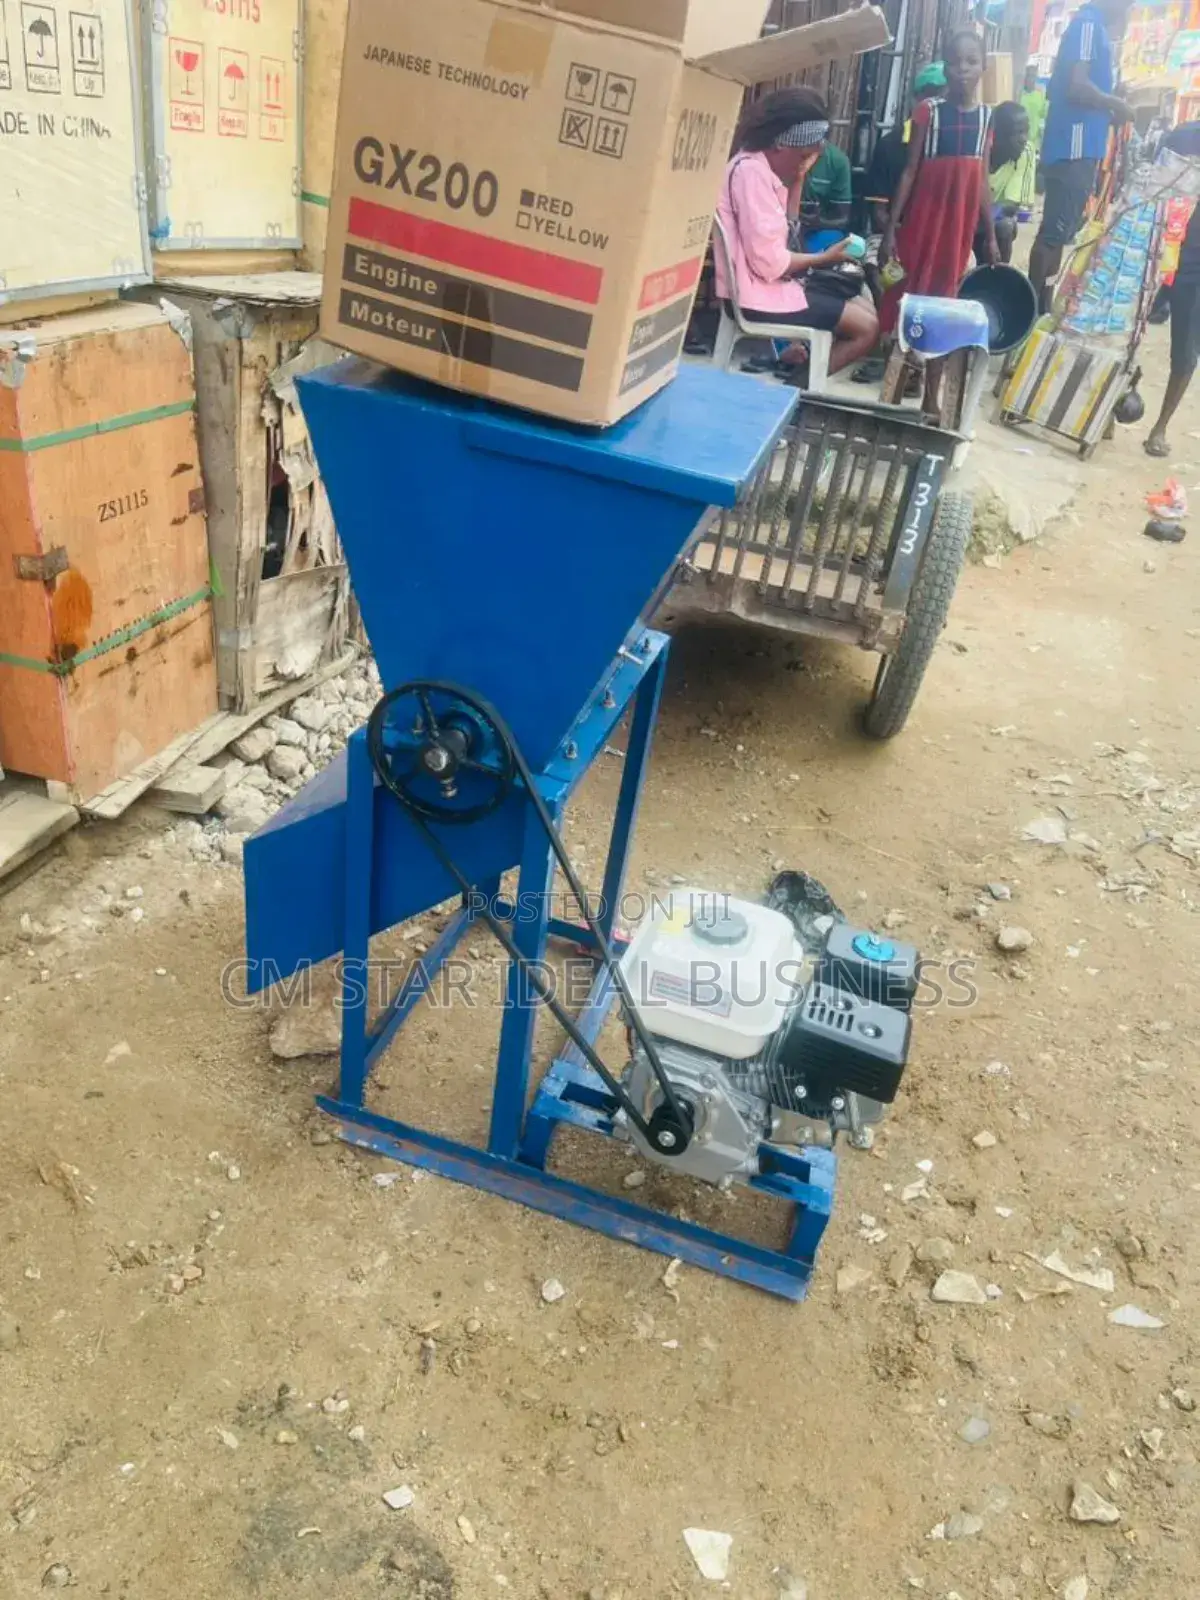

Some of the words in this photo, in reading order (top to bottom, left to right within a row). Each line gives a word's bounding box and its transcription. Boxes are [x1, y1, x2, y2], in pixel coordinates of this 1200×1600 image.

[362, 44, 432, 75] JAPANESE
[437, 62, 531, 101] TECHNOLOGY
[38, 113, 55, 136] IN
[353, 136, 499, 218] GX200
[535, 193, 574, 217] RED
[533, 215, 609, 250] YELLOW
[355, 253, 438, 295] Engine
[350, 300, 436, 341] Moteur
[98, 488, 149, 522] ZS1115
